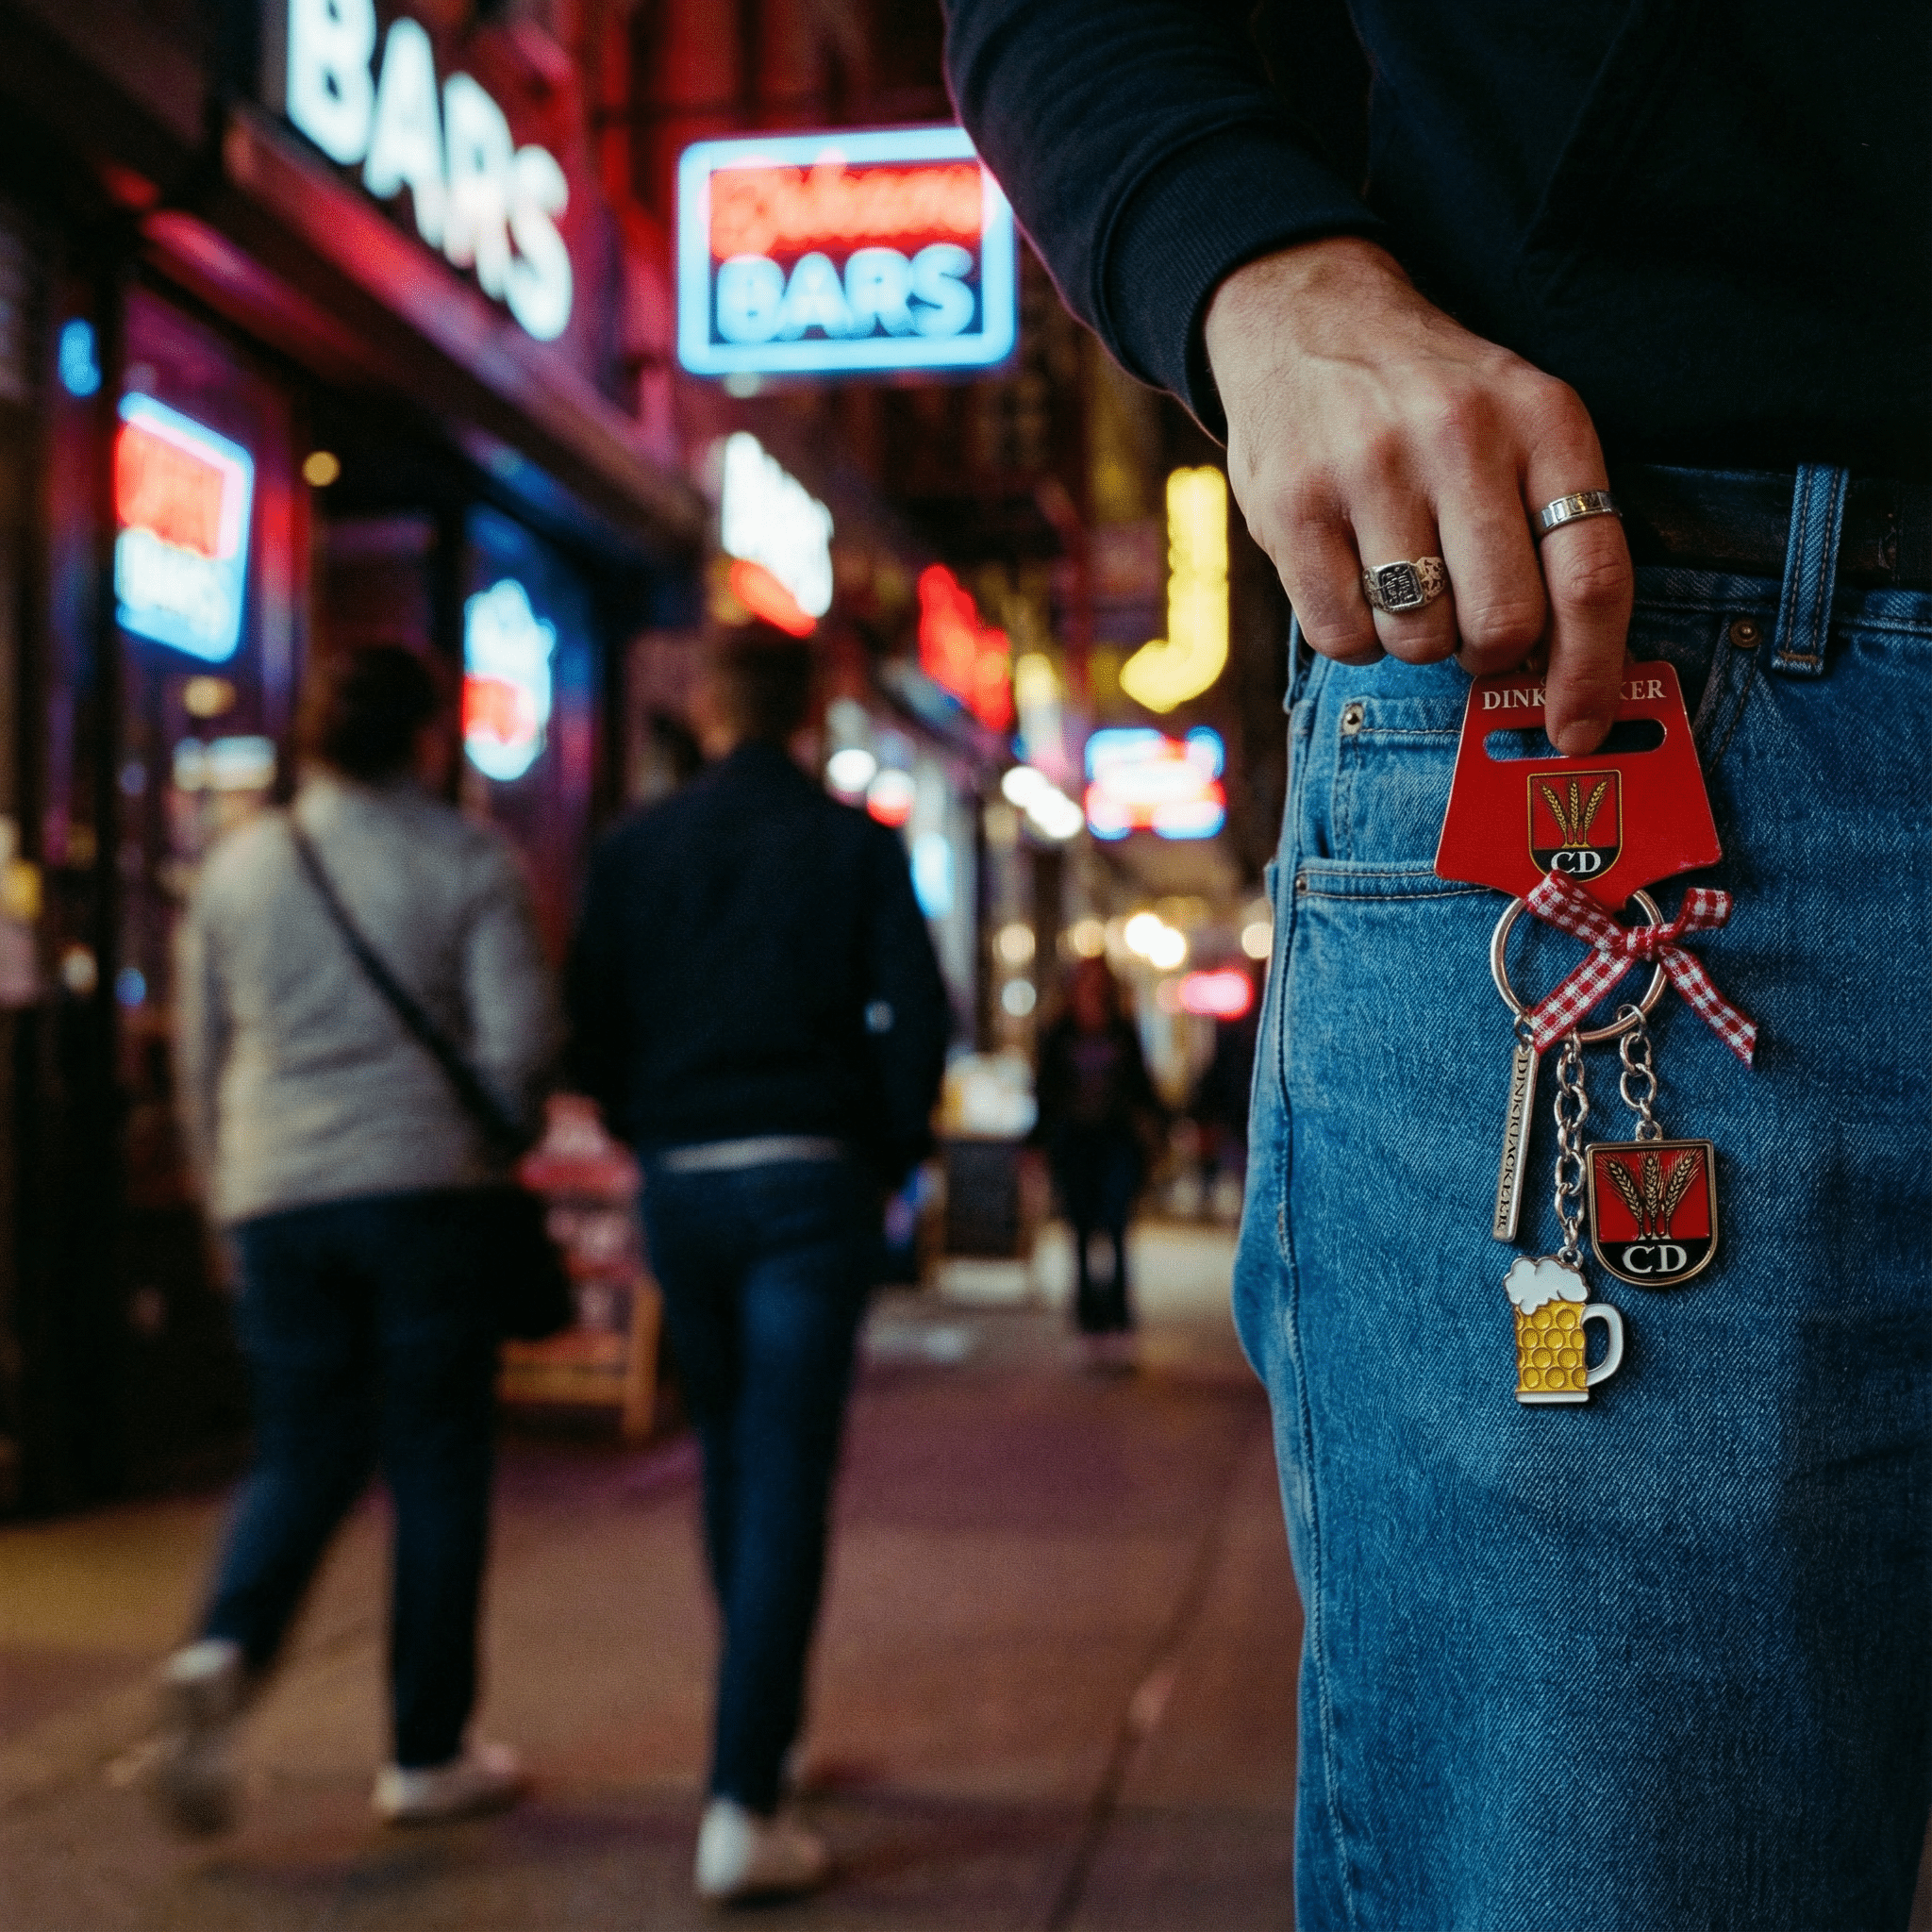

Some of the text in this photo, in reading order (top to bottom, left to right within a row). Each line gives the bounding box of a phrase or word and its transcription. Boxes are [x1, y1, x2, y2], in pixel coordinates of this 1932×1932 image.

[286, 0, 574, 341] BARS
[717, 243, 975, 343] BARS
[1551, 851, 1601, 874] CD
[1623, 1245, 1687, 1274] CD
